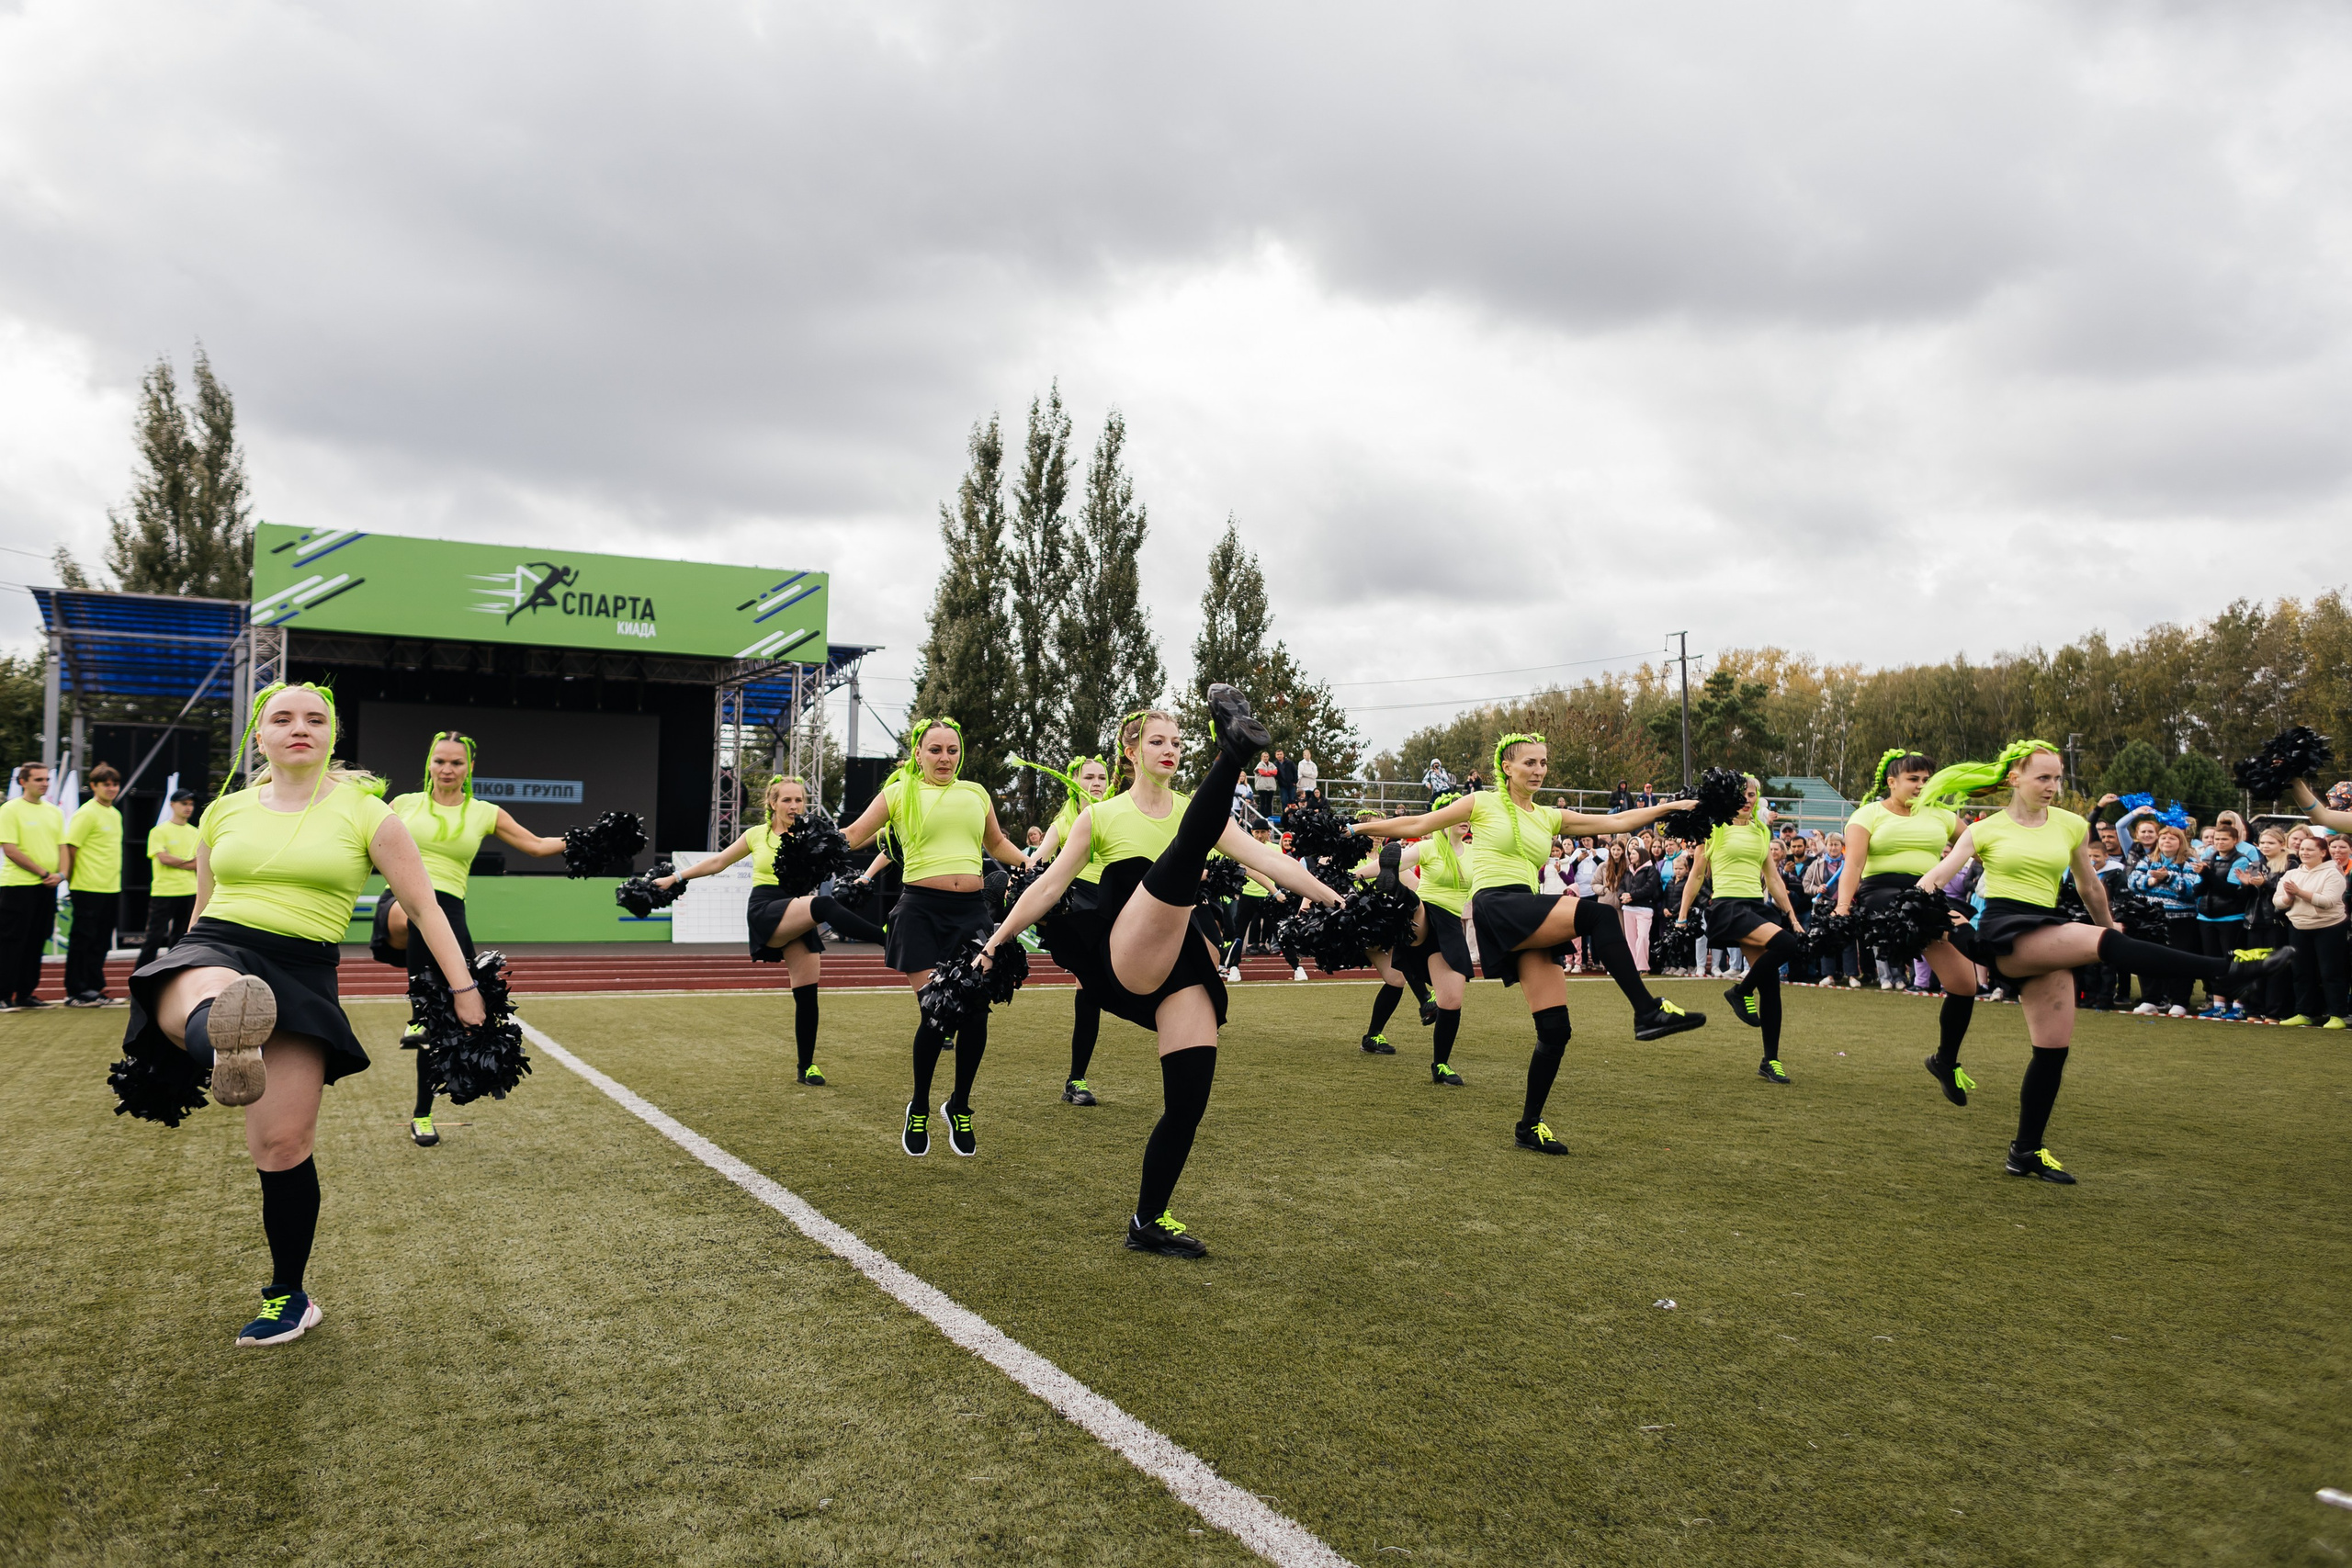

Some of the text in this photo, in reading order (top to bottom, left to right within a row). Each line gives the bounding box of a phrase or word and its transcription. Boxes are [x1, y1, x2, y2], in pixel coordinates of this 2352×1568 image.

[561, 591, 656, 621] СПАРТА
[616, 621, 657, 638] КИАДА
[522, 783, 574, 797] ГРУПП
